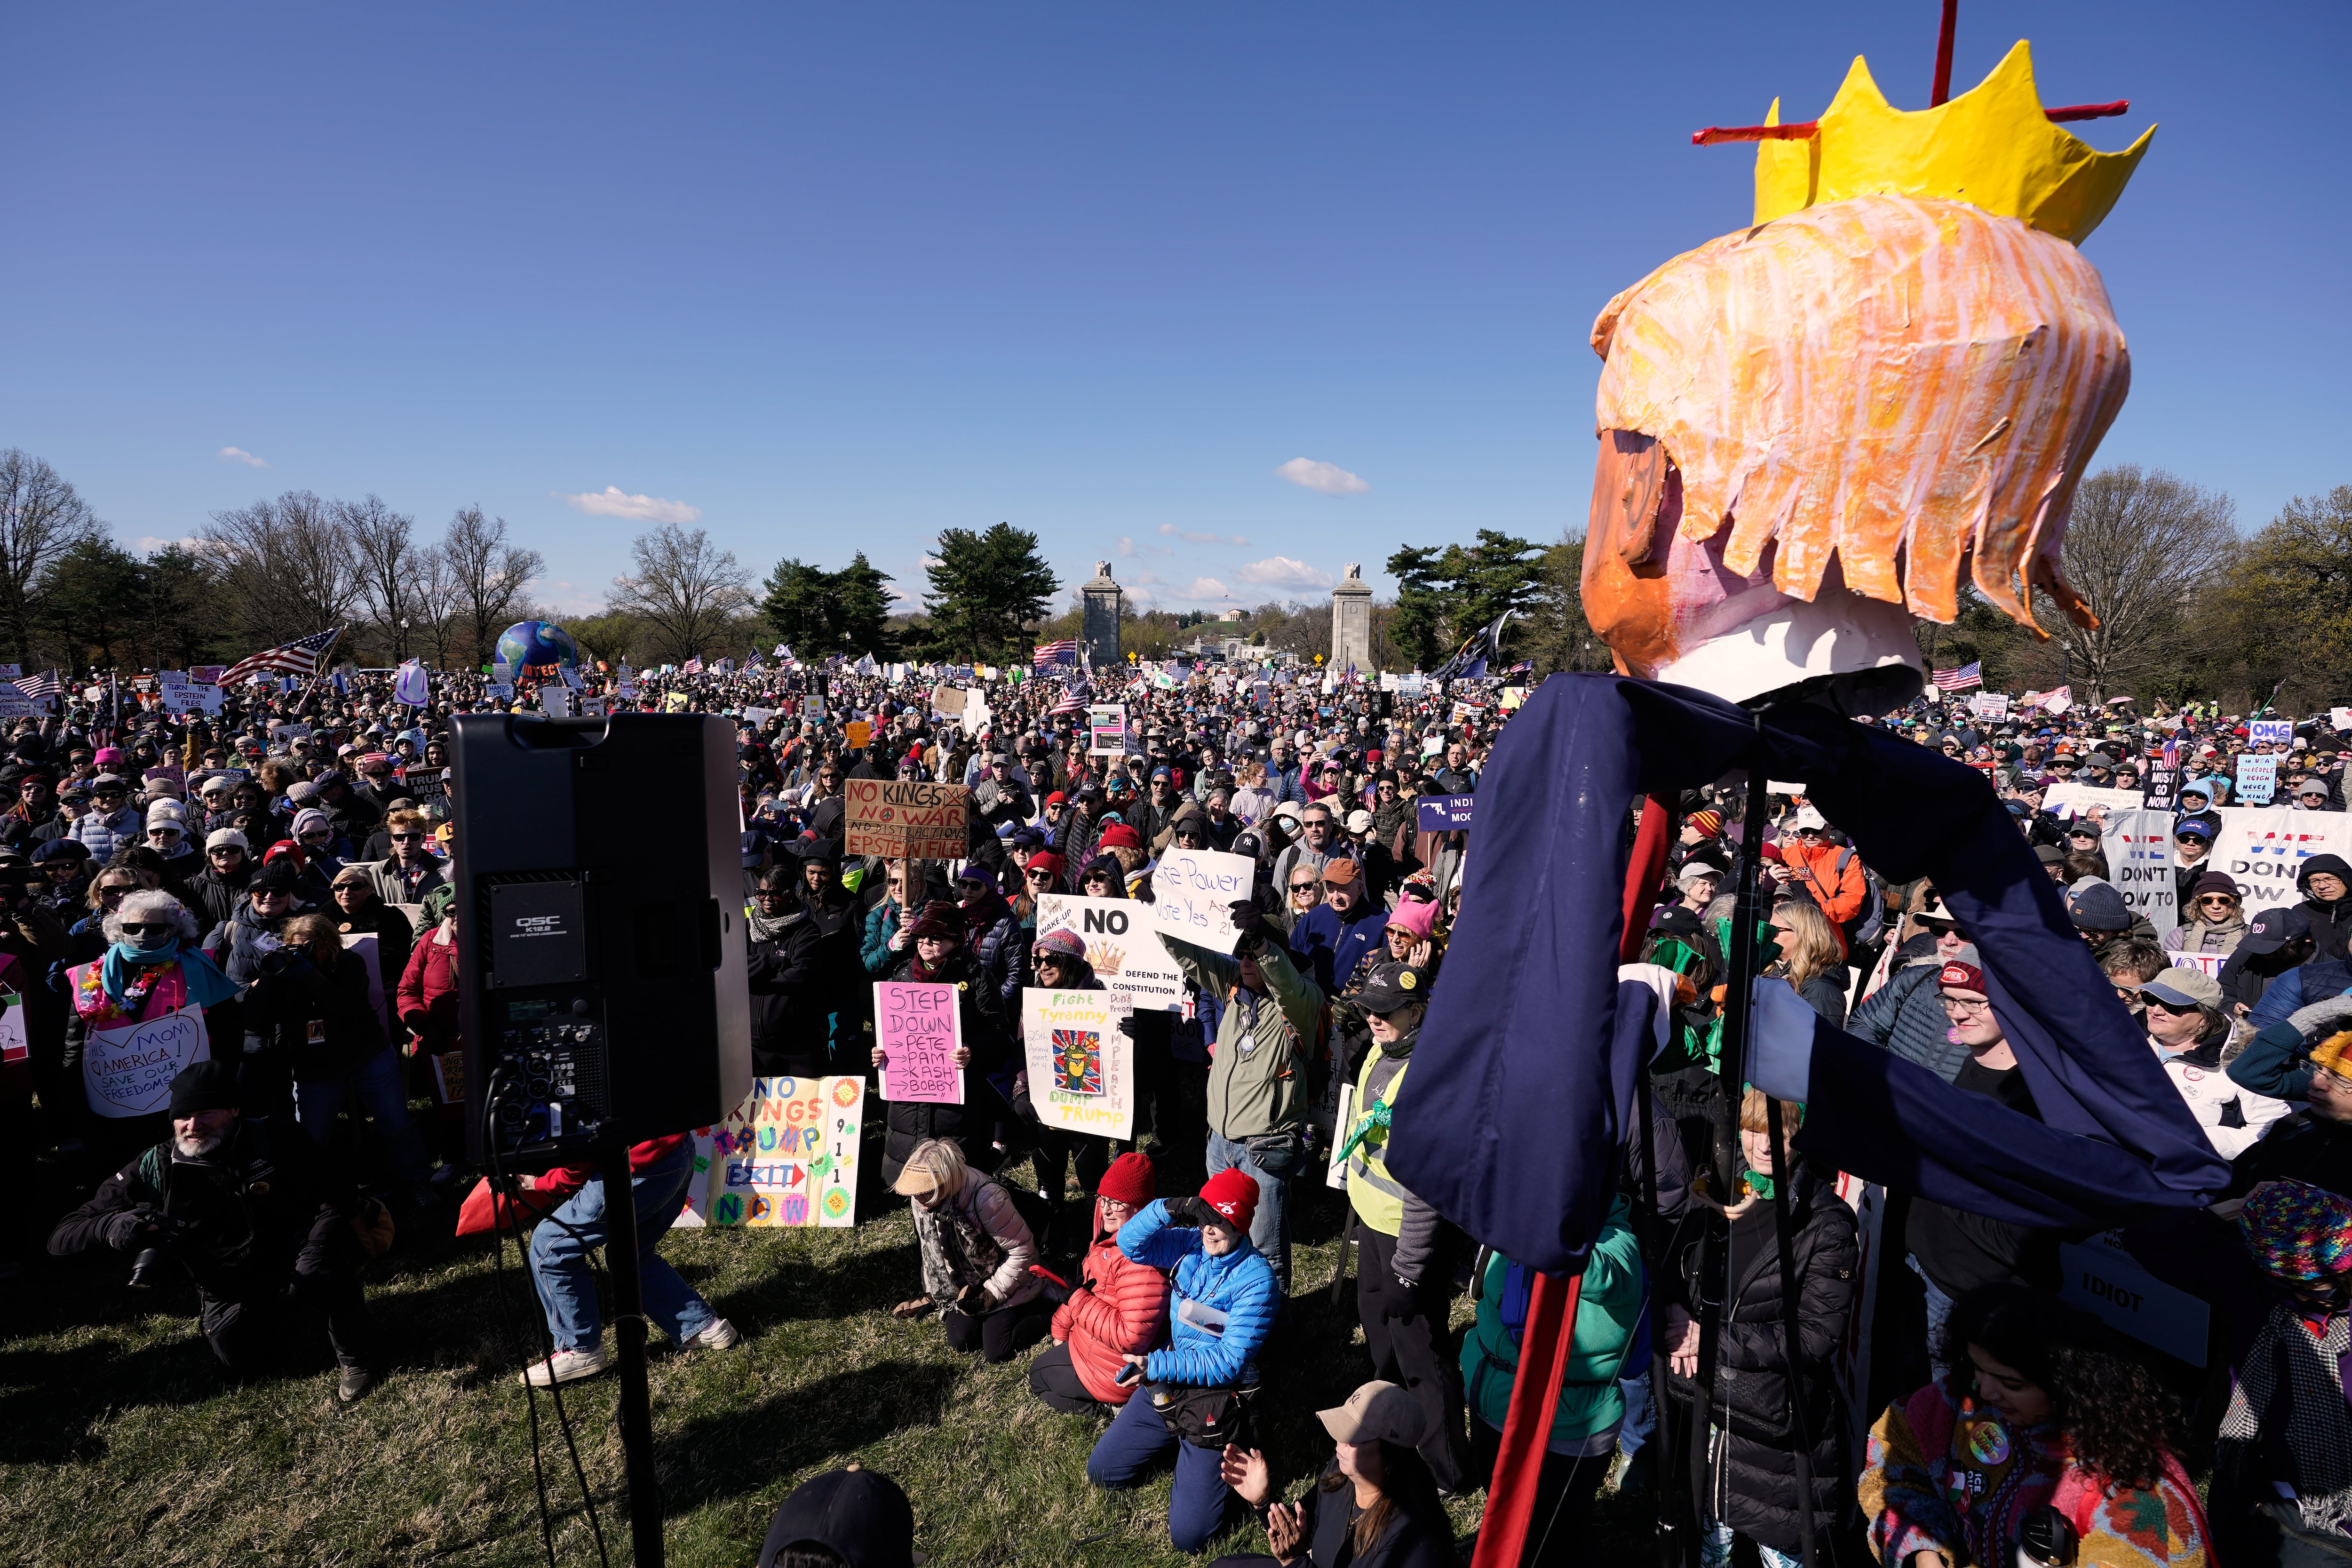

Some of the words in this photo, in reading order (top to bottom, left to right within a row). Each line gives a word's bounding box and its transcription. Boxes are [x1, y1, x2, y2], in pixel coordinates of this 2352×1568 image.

[2252, 723, 2291, 737] OMG
[408, 774, 442, 786] TRUM
[2151, 772, 2176, 783] MUST
[413, 783, 442, 795] MUS
[848, 782, 877, 803] NO
[883, 783, 944, 806] KINGS
[2155, 784, 2168, 796] GO
[1450, 798, 1473, 808] INDI
[2147, 796, 2170, 808] NOW!
[858, 806, 895, 822] NO
[901, 809, 964, 826] WAR
[850, 820, 872, 831] NO
[873, 824, 968, 840] DISTRACTIONS
[849, 835, 921, 858] EPSTEIN
[926, 840, 967, 859] FILES
[2122, 835, 2164, 860] WE
[2247, 831, 2325, 857] WE
[1155, 865, 1182, 885] ake
[1180, 859, 1244, 892] Power
[2122, 867, 2167, 882] DON'T
[2230, 860, 2296, 879] DON
[2124, 891, 2150, 906] OW
[2155, 891, 2173, 906] TO
[2236, 883, 2285, 901] OW
[1155, 893, 1181, 921] Vote
[1184, 898, 1208, 927] Yes
[516, 915, 561, 927] QSC
[1039, 908, 1072, 935] WAKE-UP
[1084, 908, 1129, 935] NO
[1219, 922, 1230, 936] 21
[1126, 970, 1160, 979] DEFEND
[1162, 973, 1179, 981] THE
[1112, 983, 1176, 995] CONSTITUTION
[889, 987, 949, 1011] STEP
[1110, 993, 1132, 1003] Don't
[888, 1014, 952, 1035] DOWN
[1039, 1008, 1107, 1025] Tyranny
[137, 1023, 190, 1051] MOM
[906, 1035, 947, 1051] PETE
[1027, 1030, 1048, 1041] 25th
[88, 1042, 106, 1057] THIS
[1028, 1043, 1049, 1053] Amend
[907, 1051, 945, 1066] PAM
[101, 1074, 135, 1088] SAVE
[145, 1060, 181, 1078] OUR
[908, 1066, 953, 1079] KASH
[754, 1077, 796, 1099] NO
[910, 1079, 955, 1091] BOBBY
[2182, 1086, 2197, 1097] PRESIDENT
[1049, 1090, 1093, 1106] DUMP
[727, 1098, 823, 1123] KINGS
[1059, 1106, 1124, 1129] TRUMP
[712, 1126, 818, 1155] TRUMP
[728, 1163, 794, 1187] EXIT
[829, 1198, 840, 1209] ICE
[834, 1196, 842, 1204] NO
[719, 1196, 804, 1221] NOW
[2082, 1272, 2144, 1313] IDIOT
[1973, 1429, 1999, 1459] WAR
[1983, 1425, 2004, 1448] NO
